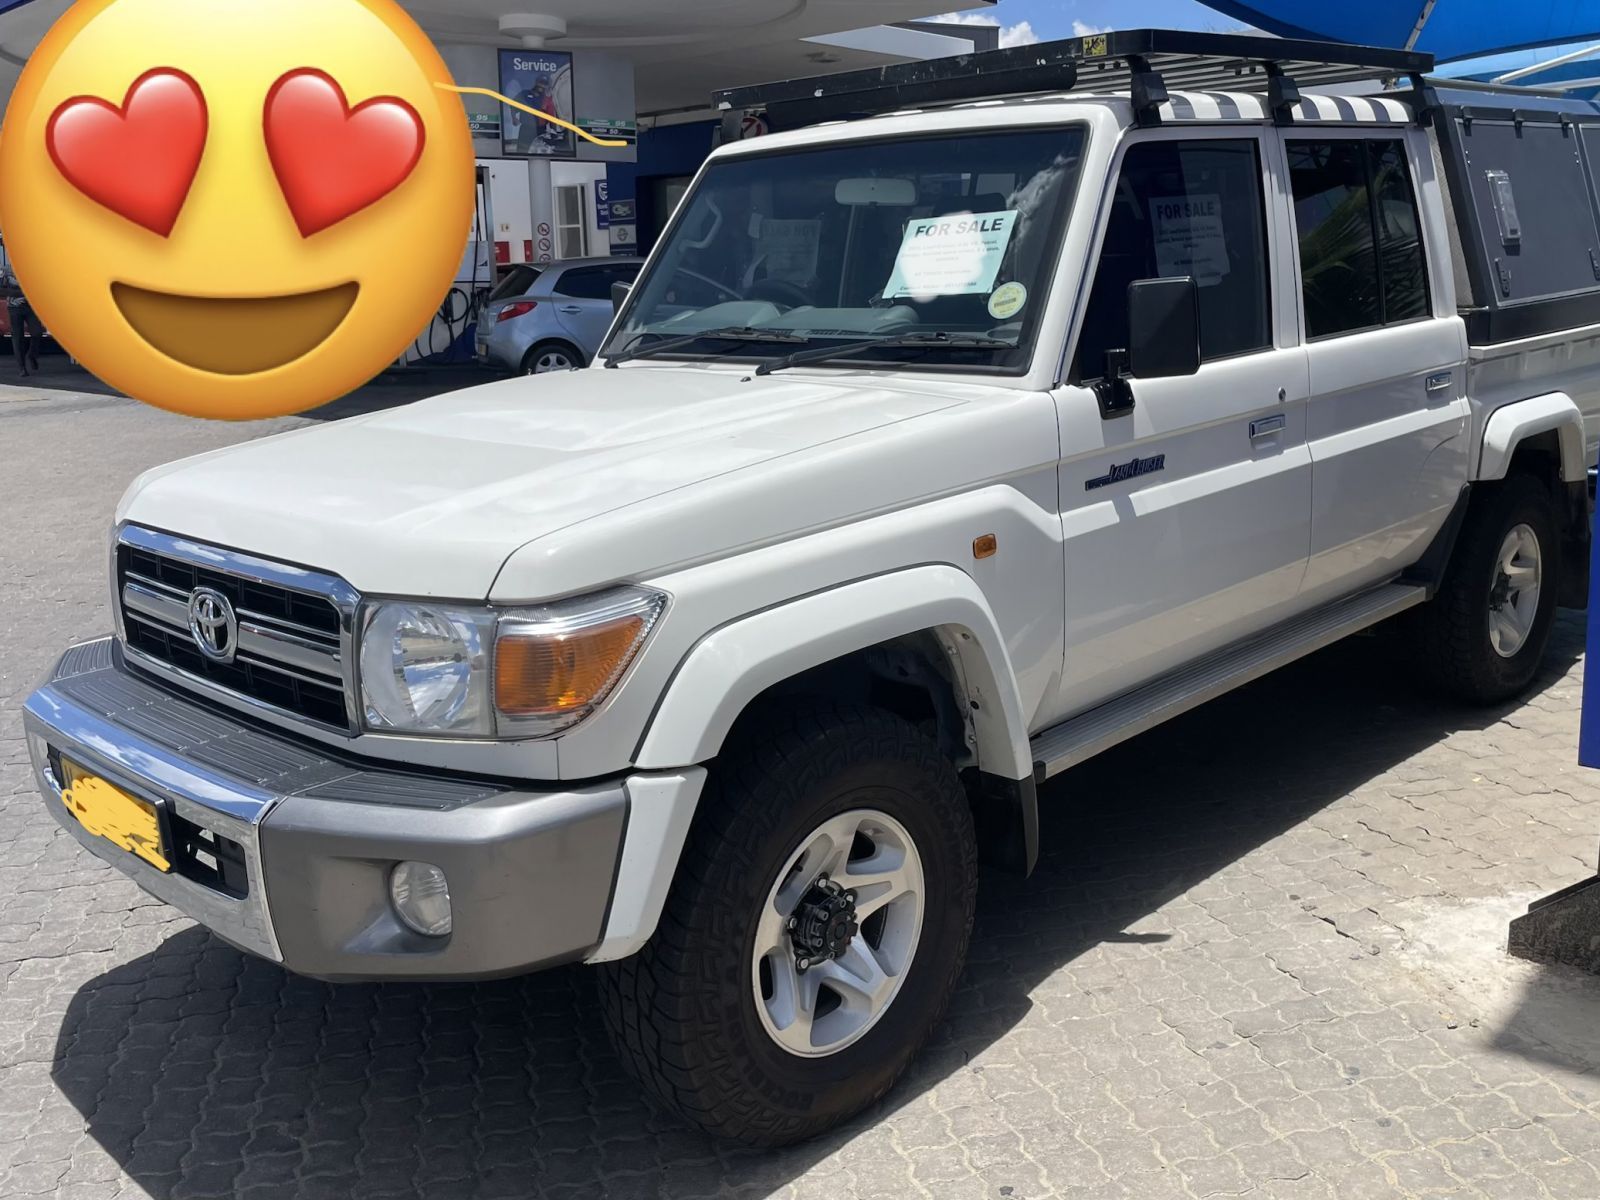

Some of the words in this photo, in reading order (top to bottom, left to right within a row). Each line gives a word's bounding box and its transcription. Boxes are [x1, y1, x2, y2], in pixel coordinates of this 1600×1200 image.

[513, 58, 557, 72] Service
[1156, 203, 1182, 220] FOR
[1184, 201, 1215, 218] SALE
[914, 223, 951, 238] FOR
[955, 217, 1004, 234] SALE
